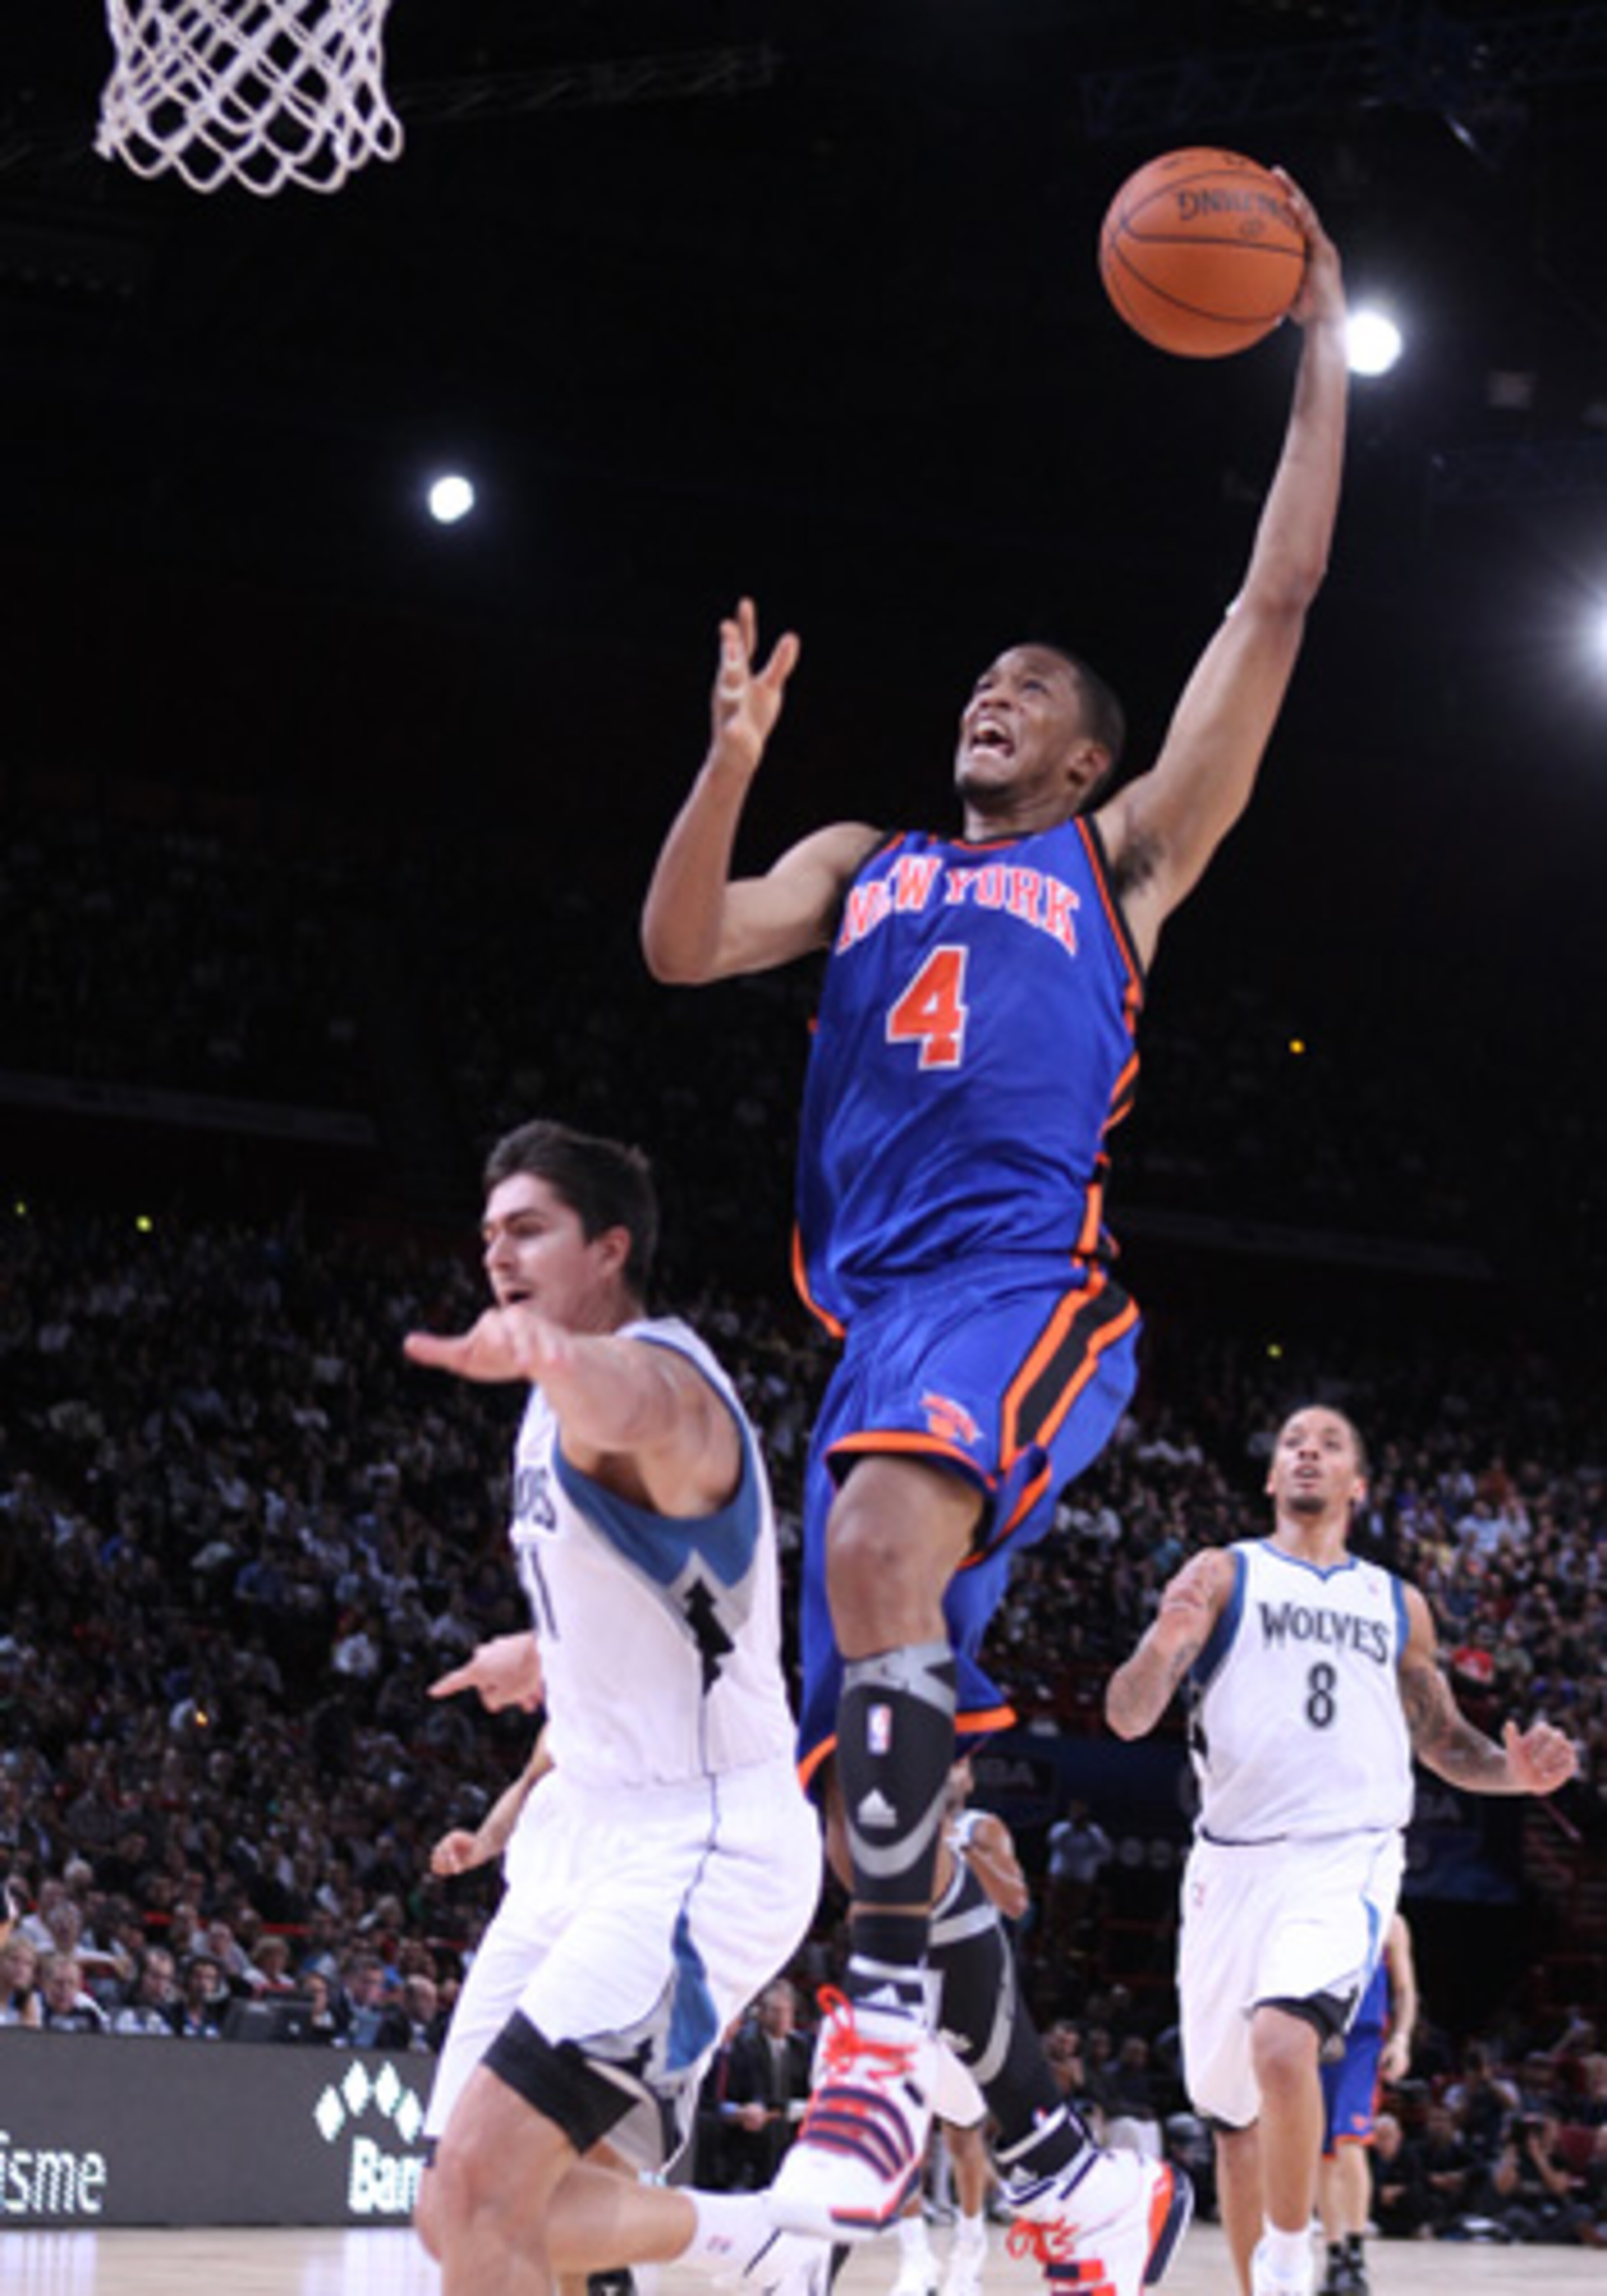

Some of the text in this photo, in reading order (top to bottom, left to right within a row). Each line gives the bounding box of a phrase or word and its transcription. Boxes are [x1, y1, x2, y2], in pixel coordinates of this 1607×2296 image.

[945, 863, 1081, 957] YORK
[886, 945, 968, 1071] 4
[1258, 1601, 1390, 1666] WOLVES
[1305, 1660, 1337, 1729] 8
